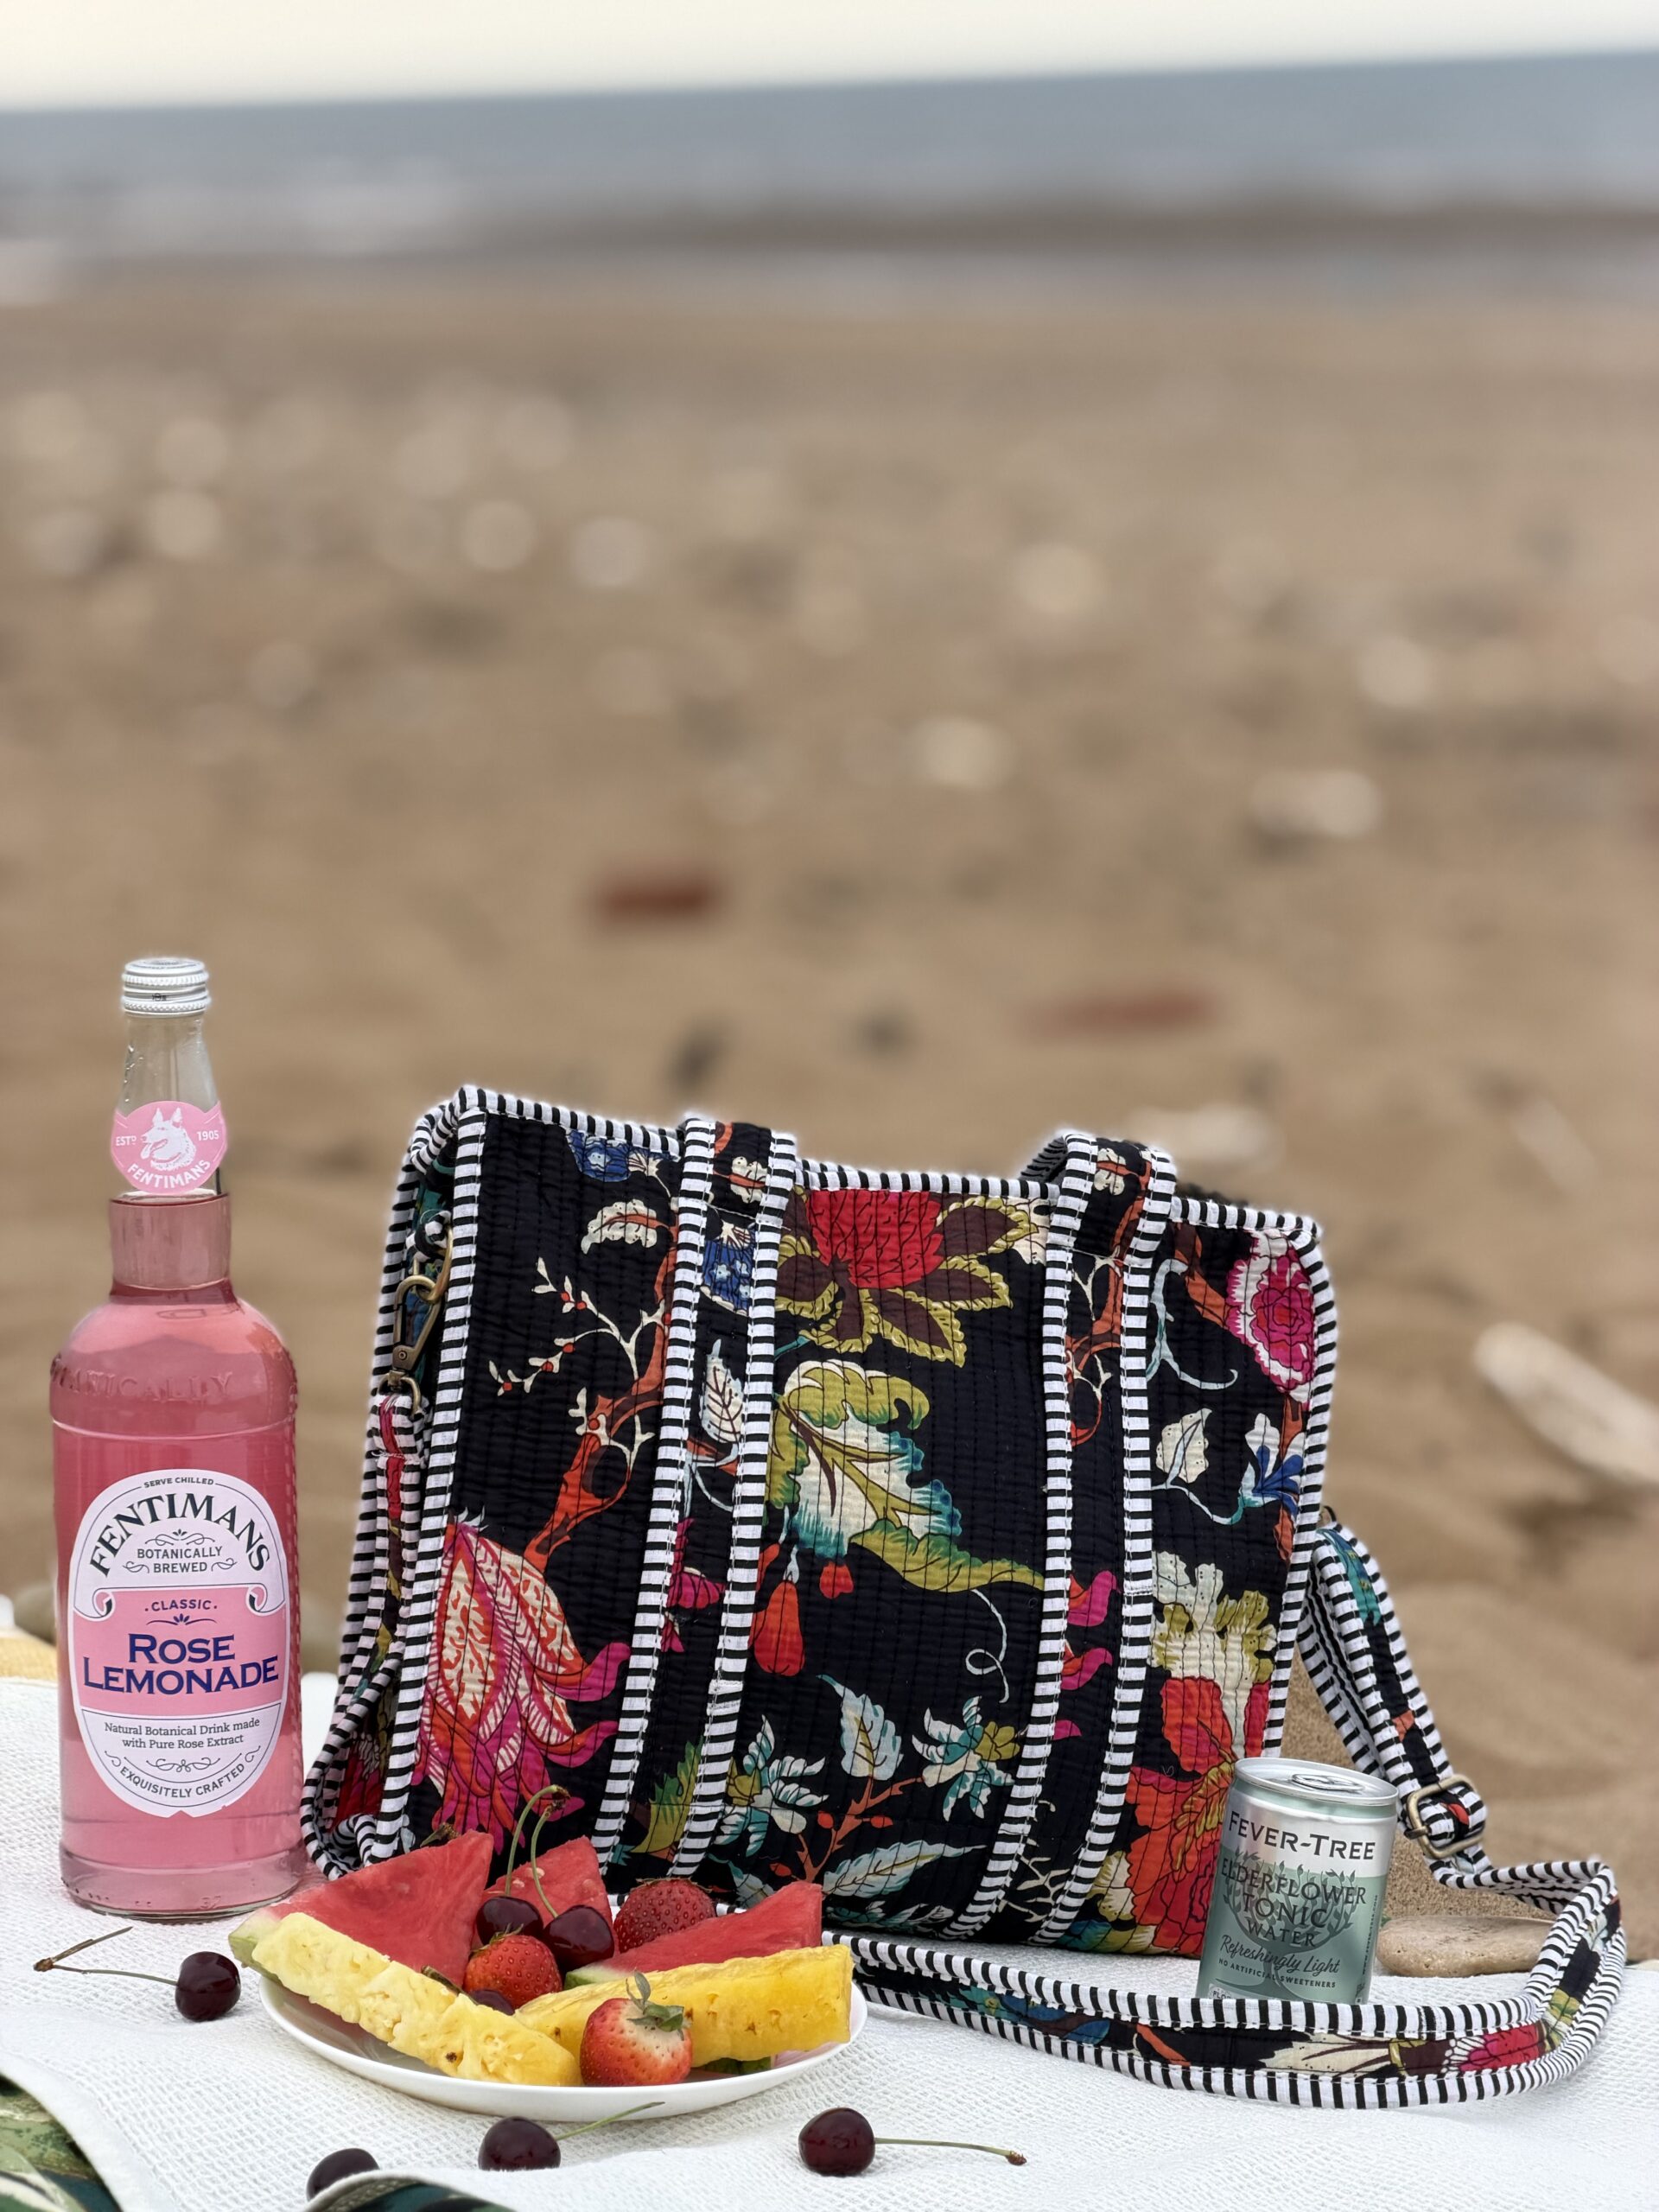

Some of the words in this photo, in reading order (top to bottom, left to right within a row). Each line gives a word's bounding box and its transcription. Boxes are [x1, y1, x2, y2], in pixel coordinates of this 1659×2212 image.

[196, 1129, 220, 1141] 1905
[127, 1160, 212, 1189] FENTIMANS
[143, 1478, 173, 1488] SERVE
[175, 1477, 214, 1485] CHILLED
[89, 1492, 270, 1578] FENTIMANS
[137, 1546, 223, 1560] BOTANICALLY
[153, 1561, 207, 1573] BREWED
[151, 1599, 212, 1611] CLASSIC
[128, 1633, 235, 1664] ROSE
[83, 1655, 279, 1695] LEMONADE
[105, 1721, 143, 1735] Natural
[145, 1725, 197, 1736] Botanical
[200, 1722, 230, 1735] Drink
[232, 1718, 260, 1729] made
[122, 1737, 146, 1748] with
[149, 1739, 174, 1749] Pure
[178, 1738, 204, 1749] Rose
[207, 1734, 244, 1747] Extract
[120, 1766, 192, 1798] EXQUISITELY
[195, 1763, 245, 1796] CRAFTED
[1228, 1810, 1376, 1860] FEVER-TREE
[1221, 1858, 1367, 1904] ELDERFLOWER
[1243, 1892, 1328, 1929] TONIC
[1244, 1916, 1316, 1948] WATER
[1219, 1934, 1300, 1974] Refreshingly
[1303, 1955, 1341, 1977] Light
[1218, 1957, 1228, 1967] NO
[1230, 1962, 1276, 1981] ARTIFICIAL
[1280, 1975, 1337, 1988] SWEETENERS
